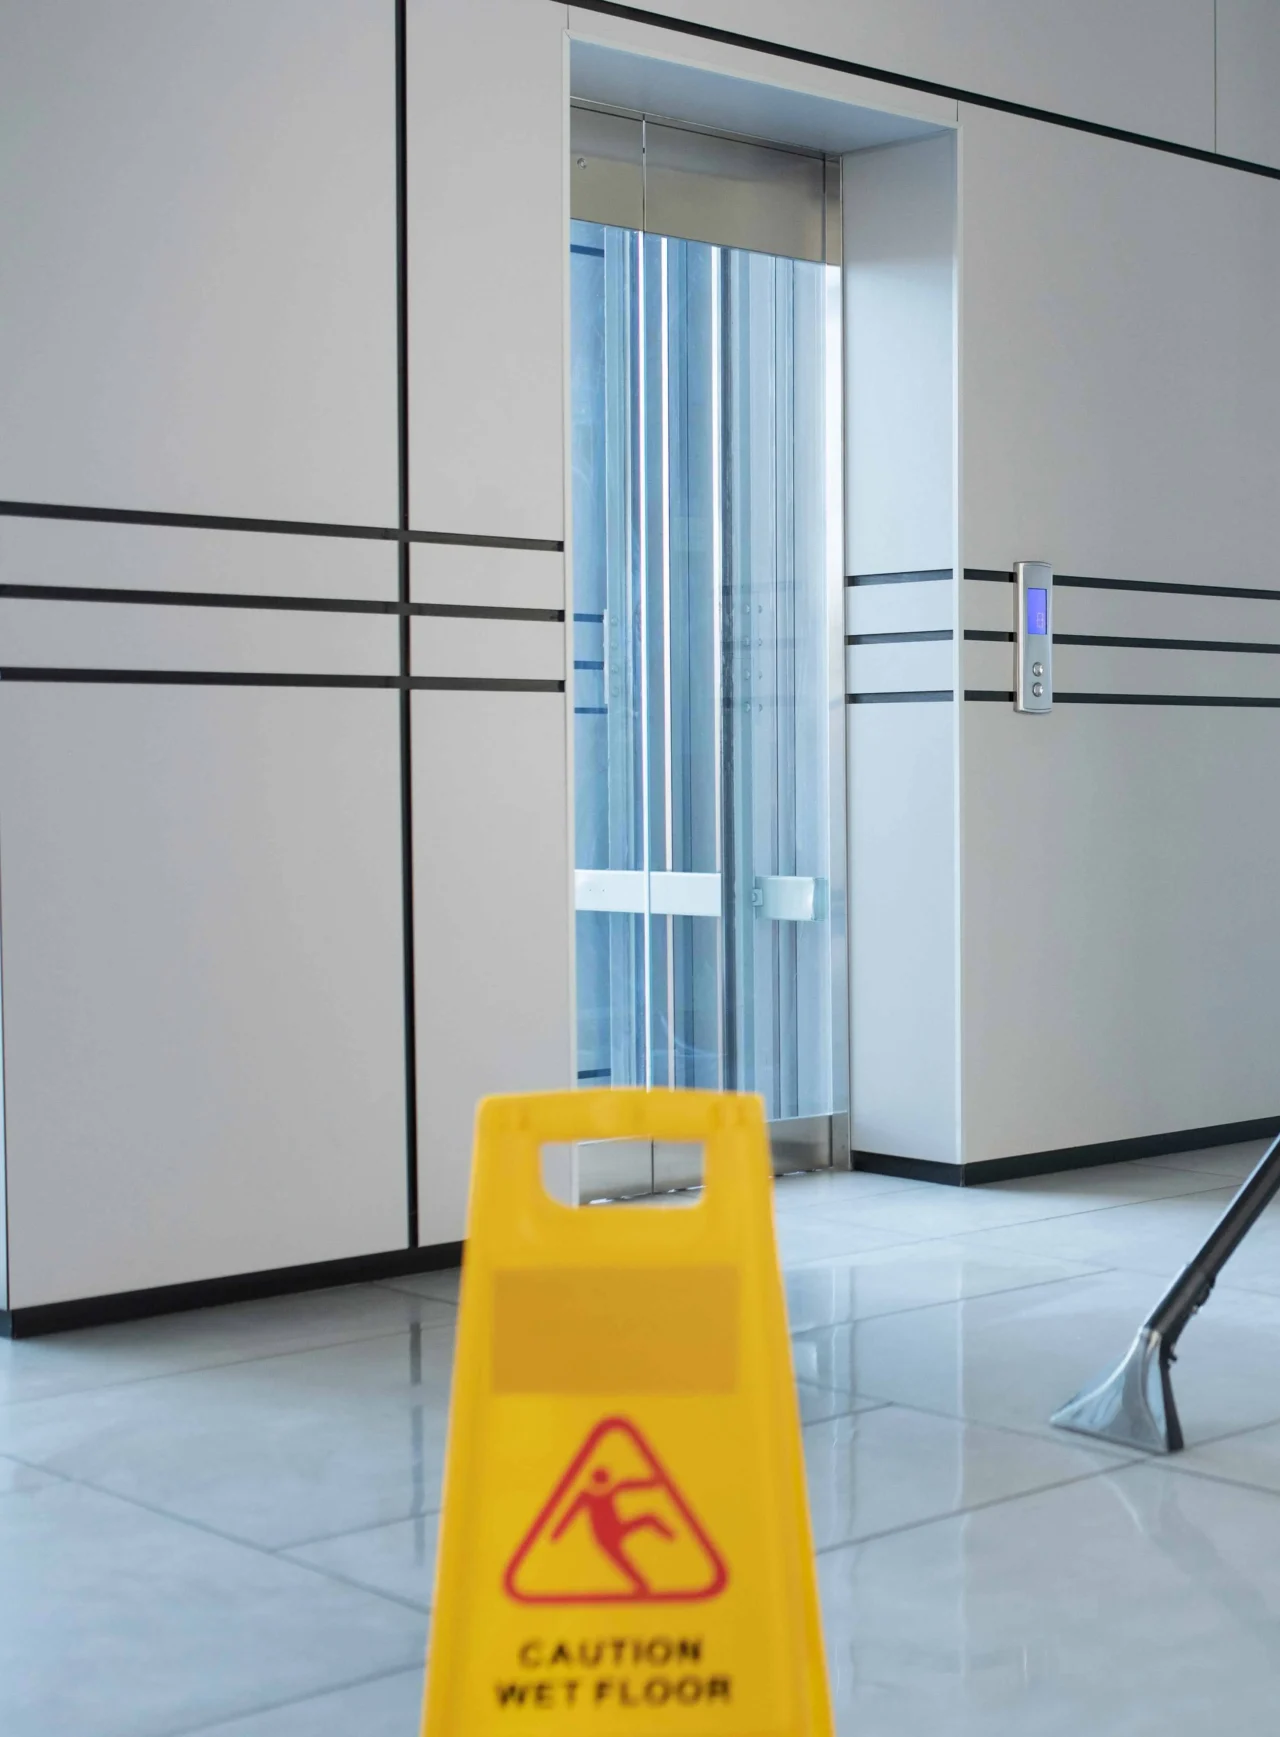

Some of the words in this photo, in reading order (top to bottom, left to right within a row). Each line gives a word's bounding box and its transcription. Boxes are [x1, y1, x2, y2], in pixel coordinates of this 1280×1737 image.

[518, 1635, 704, 1668] CAUTION
[496, 1680, 578, 1709] WET
[594, 1676, 732, 1707] FLOOR
